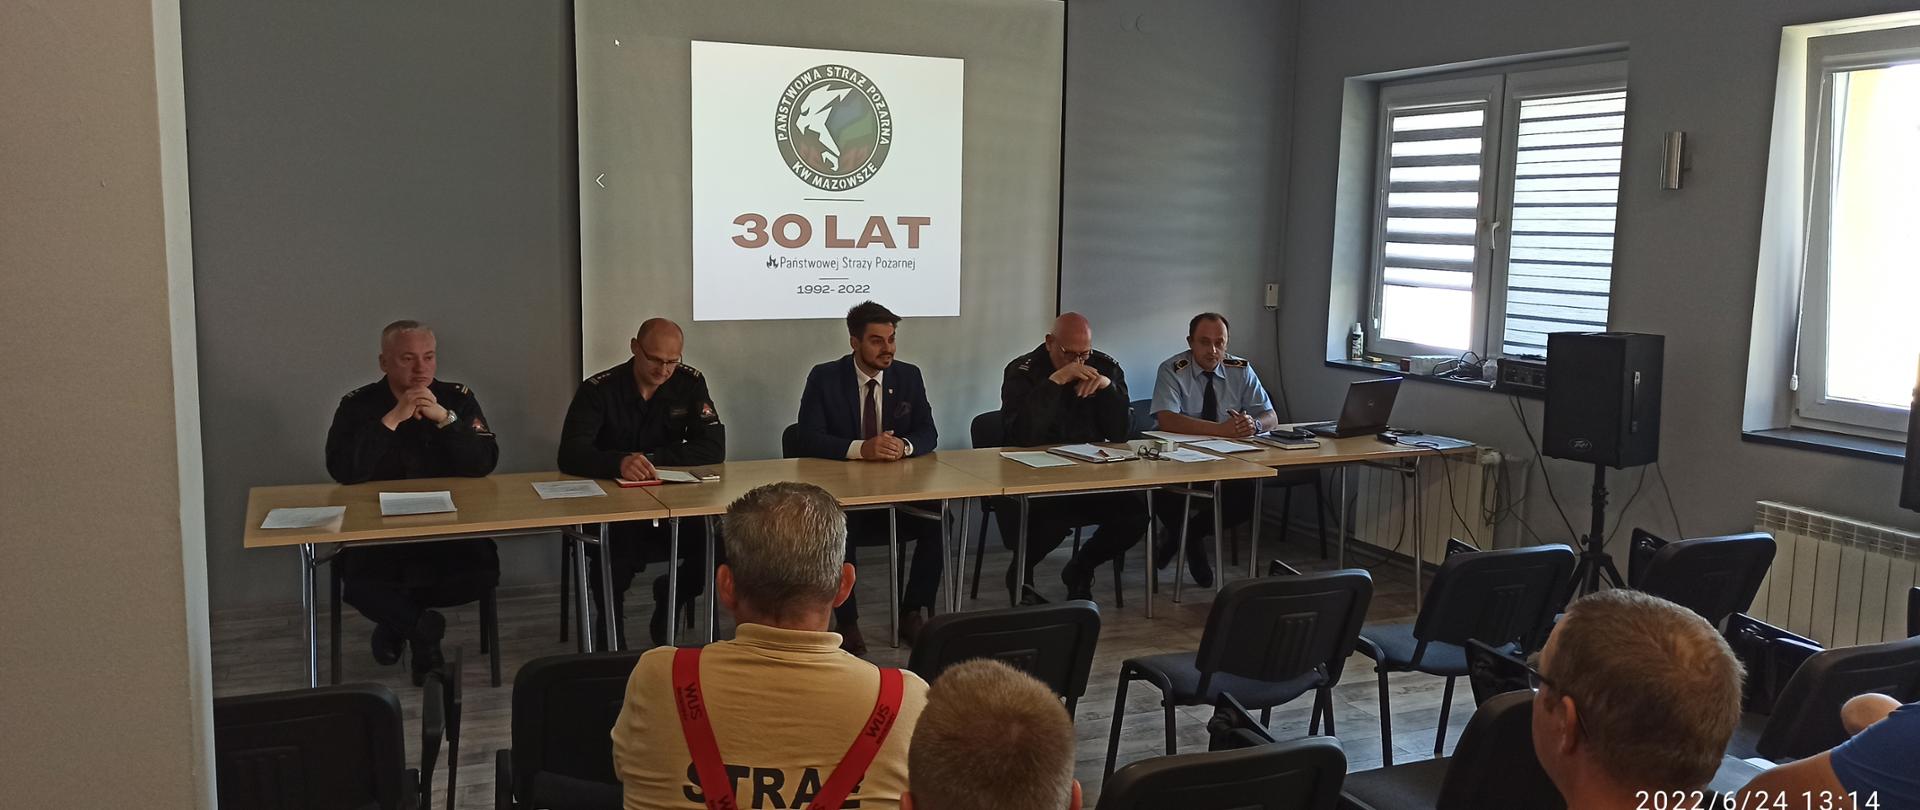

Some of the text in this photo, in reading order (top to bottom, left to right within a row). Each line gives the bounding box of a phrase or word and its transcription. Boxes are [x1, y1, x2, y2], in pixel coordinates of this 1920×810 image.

[792, 161, 878, 190] KW MAZOWSZE
[731, 213, 931, 249] 30 LAT
[838, 284, 871, 294] 2022
